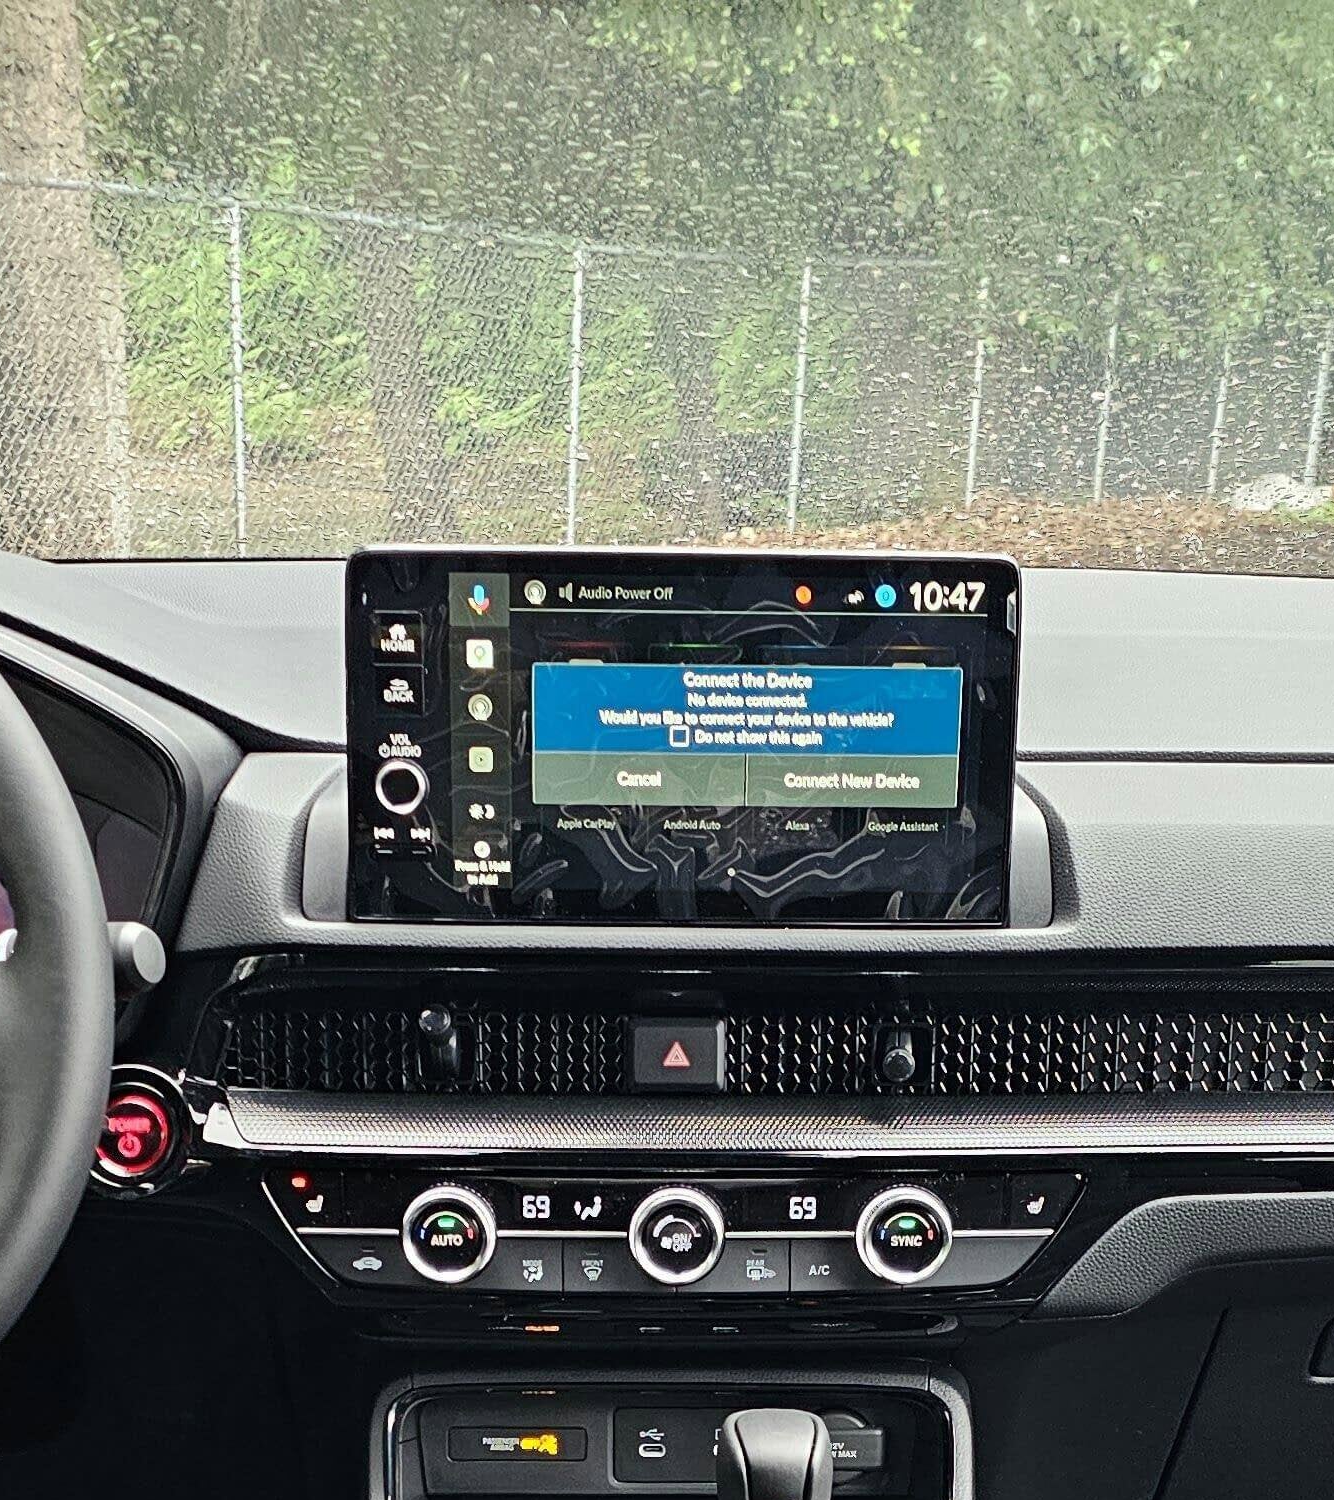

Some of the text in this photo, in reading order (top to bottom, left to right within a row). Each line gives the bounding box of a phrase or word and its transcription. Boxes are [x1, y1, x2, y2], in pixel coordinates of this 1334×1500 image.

[578, 586, 674, 601] Audio Power Off
[909, 580, 986, 612] 10:47
[380, 638, 415, 653] HOME
[683, 671, 812, 689] Connect the Device
[383, 689, 415, 703] BACK
[687, 692, 808, 709] No device connected.
[598, 709, 895, 729] Would you like to connect your device to the vehicle?
[389, 733, 411, 745] VOL
[694, 729, 823, 747] Do not show this again
[390, 744, 422, 758] AUDIO
[617, 770, 662, 787] Cancel
[783, 772, 921, 789] Connect New Device
[557, 818, 616, 831] Apple CarPlay
[663, 819, 721, 831] Android Auto
[785, 820, 811, 832] Alexa
[868, 821, 939, 833] Google Assistant
[522, 1194, 551, 1219] 69
[788, 1196, 817, 1220] 69
[430, 1234, 464, 1247] AUTO
[890, 1235, 923, 1248] SYNC
[522, 1258, 543, 1267] MODE
[808, 1263, 831, 1276] A/C
[838, 1450, 857, 1459] MAX
